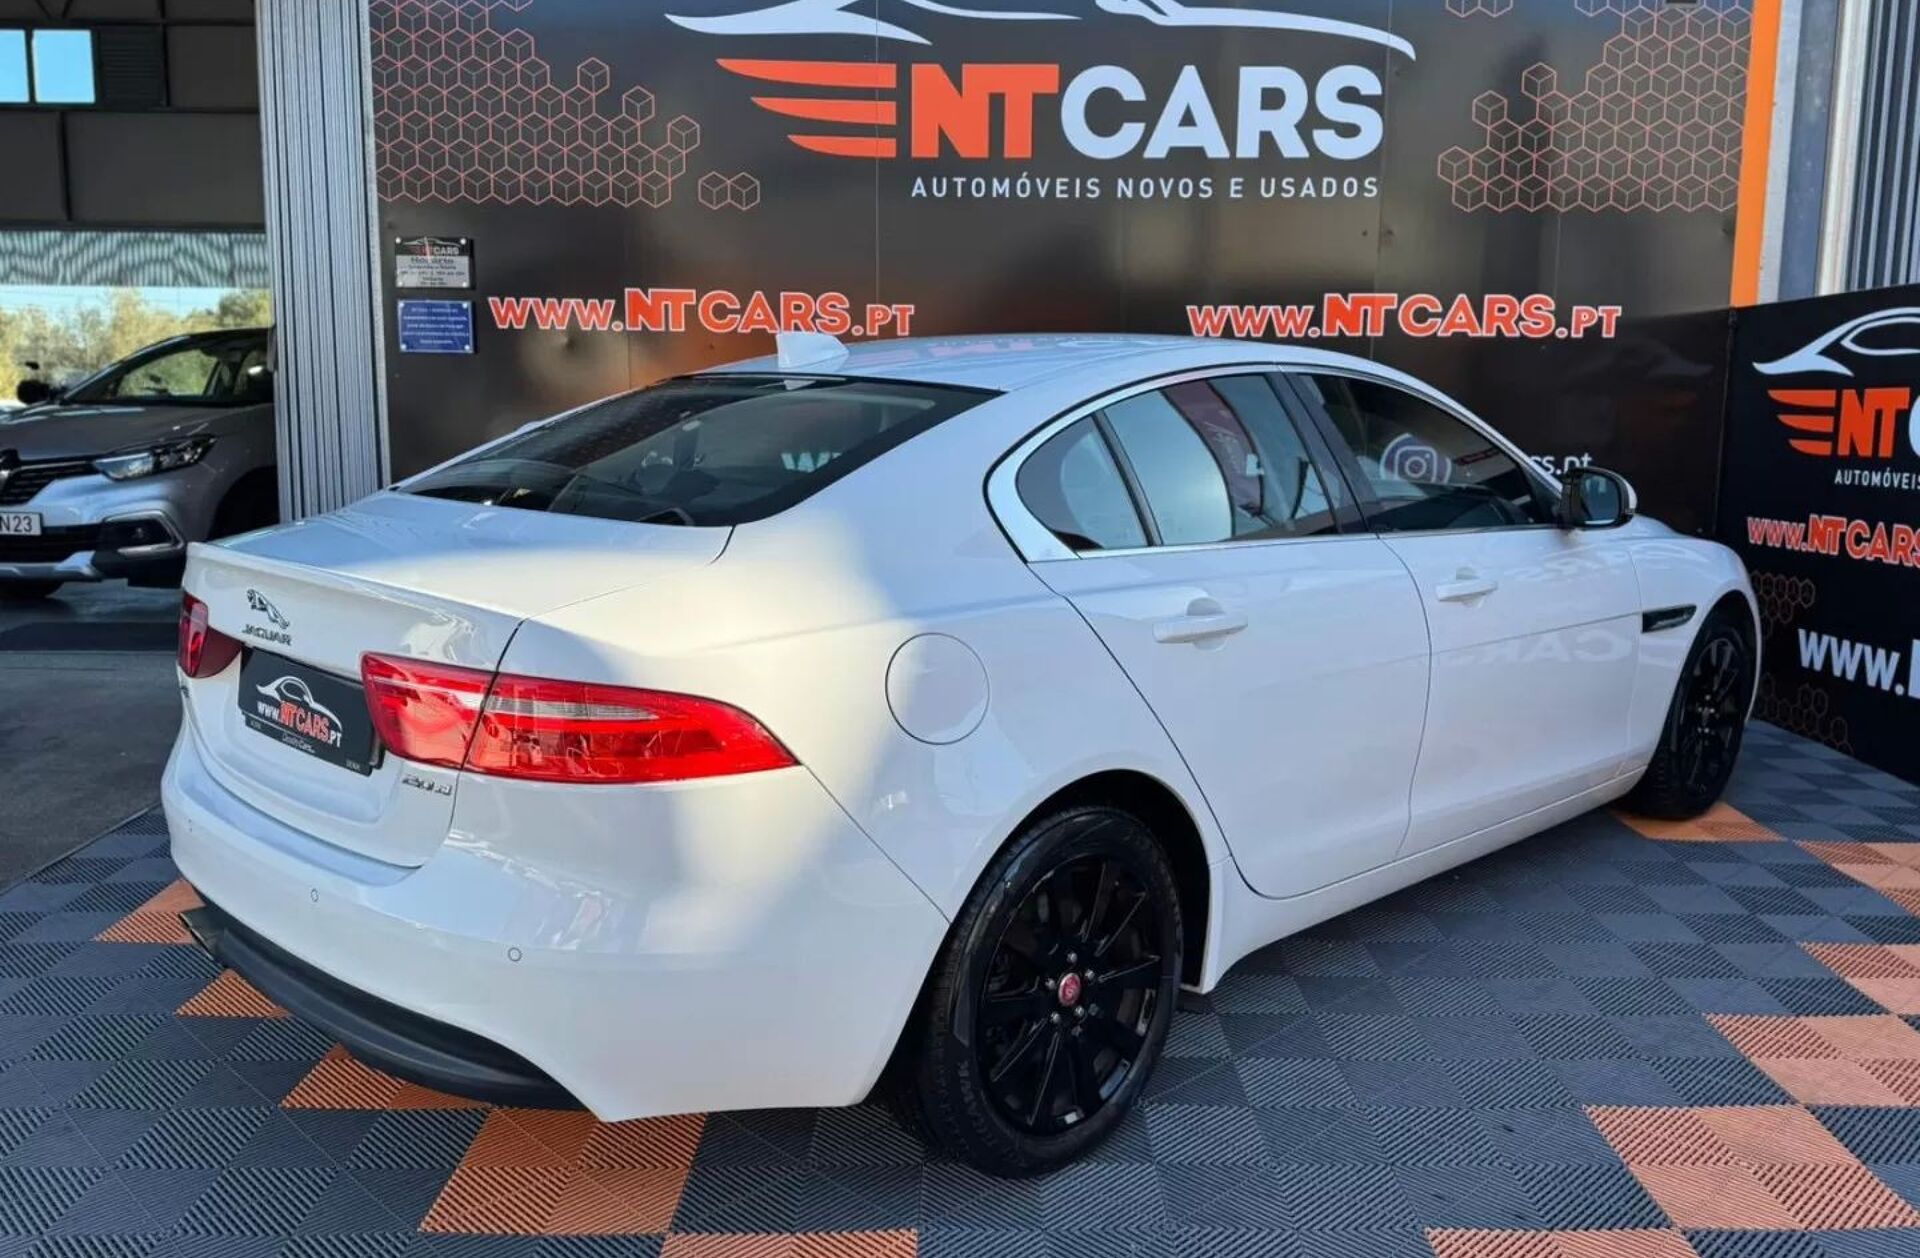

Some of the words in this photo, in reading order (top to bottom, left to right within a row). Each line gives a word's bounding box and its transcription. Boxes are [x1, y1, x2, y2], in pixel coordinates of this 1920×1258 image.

[911, 172, 1100, 198] AUTOMÓVEIS
[1117, 177, 1213, 198] NOVOS
[1230, 178, 1243, 197] E
[1260, 177, 1379, 198] USADOS
[242, 624, 292, 646] JAGUAR
